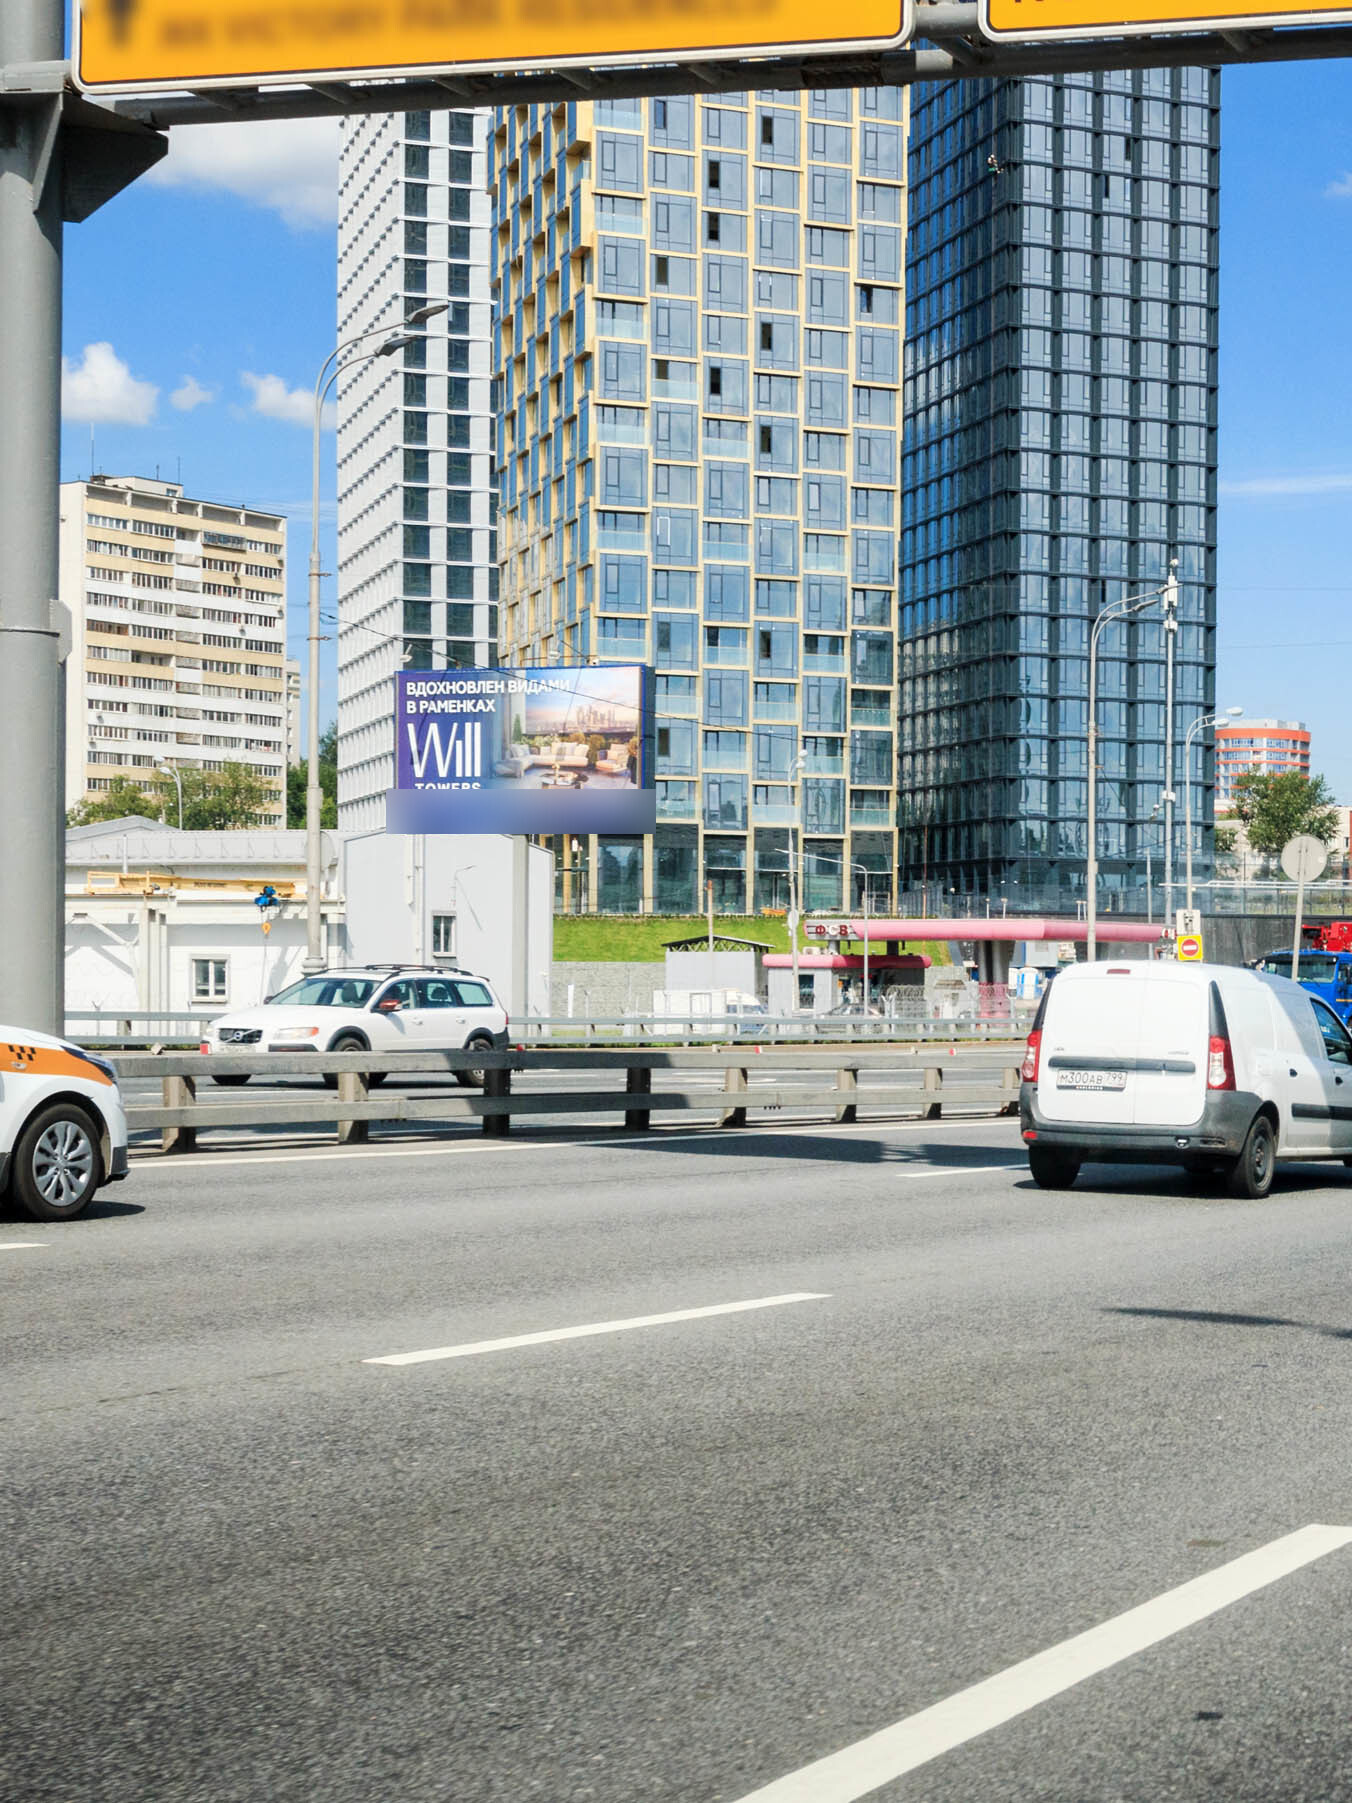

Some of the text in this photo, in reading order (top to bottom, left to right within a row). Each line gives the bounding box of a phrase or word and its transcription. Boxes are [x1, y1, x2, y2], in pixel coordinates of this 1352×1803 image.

[406, 680, 570, 697] ВДОХНОВЛЕН ВИДАМИ
[406, 699, 496, 714] В РАМЕНКАХ
[407, 722, 481, 778] Will
